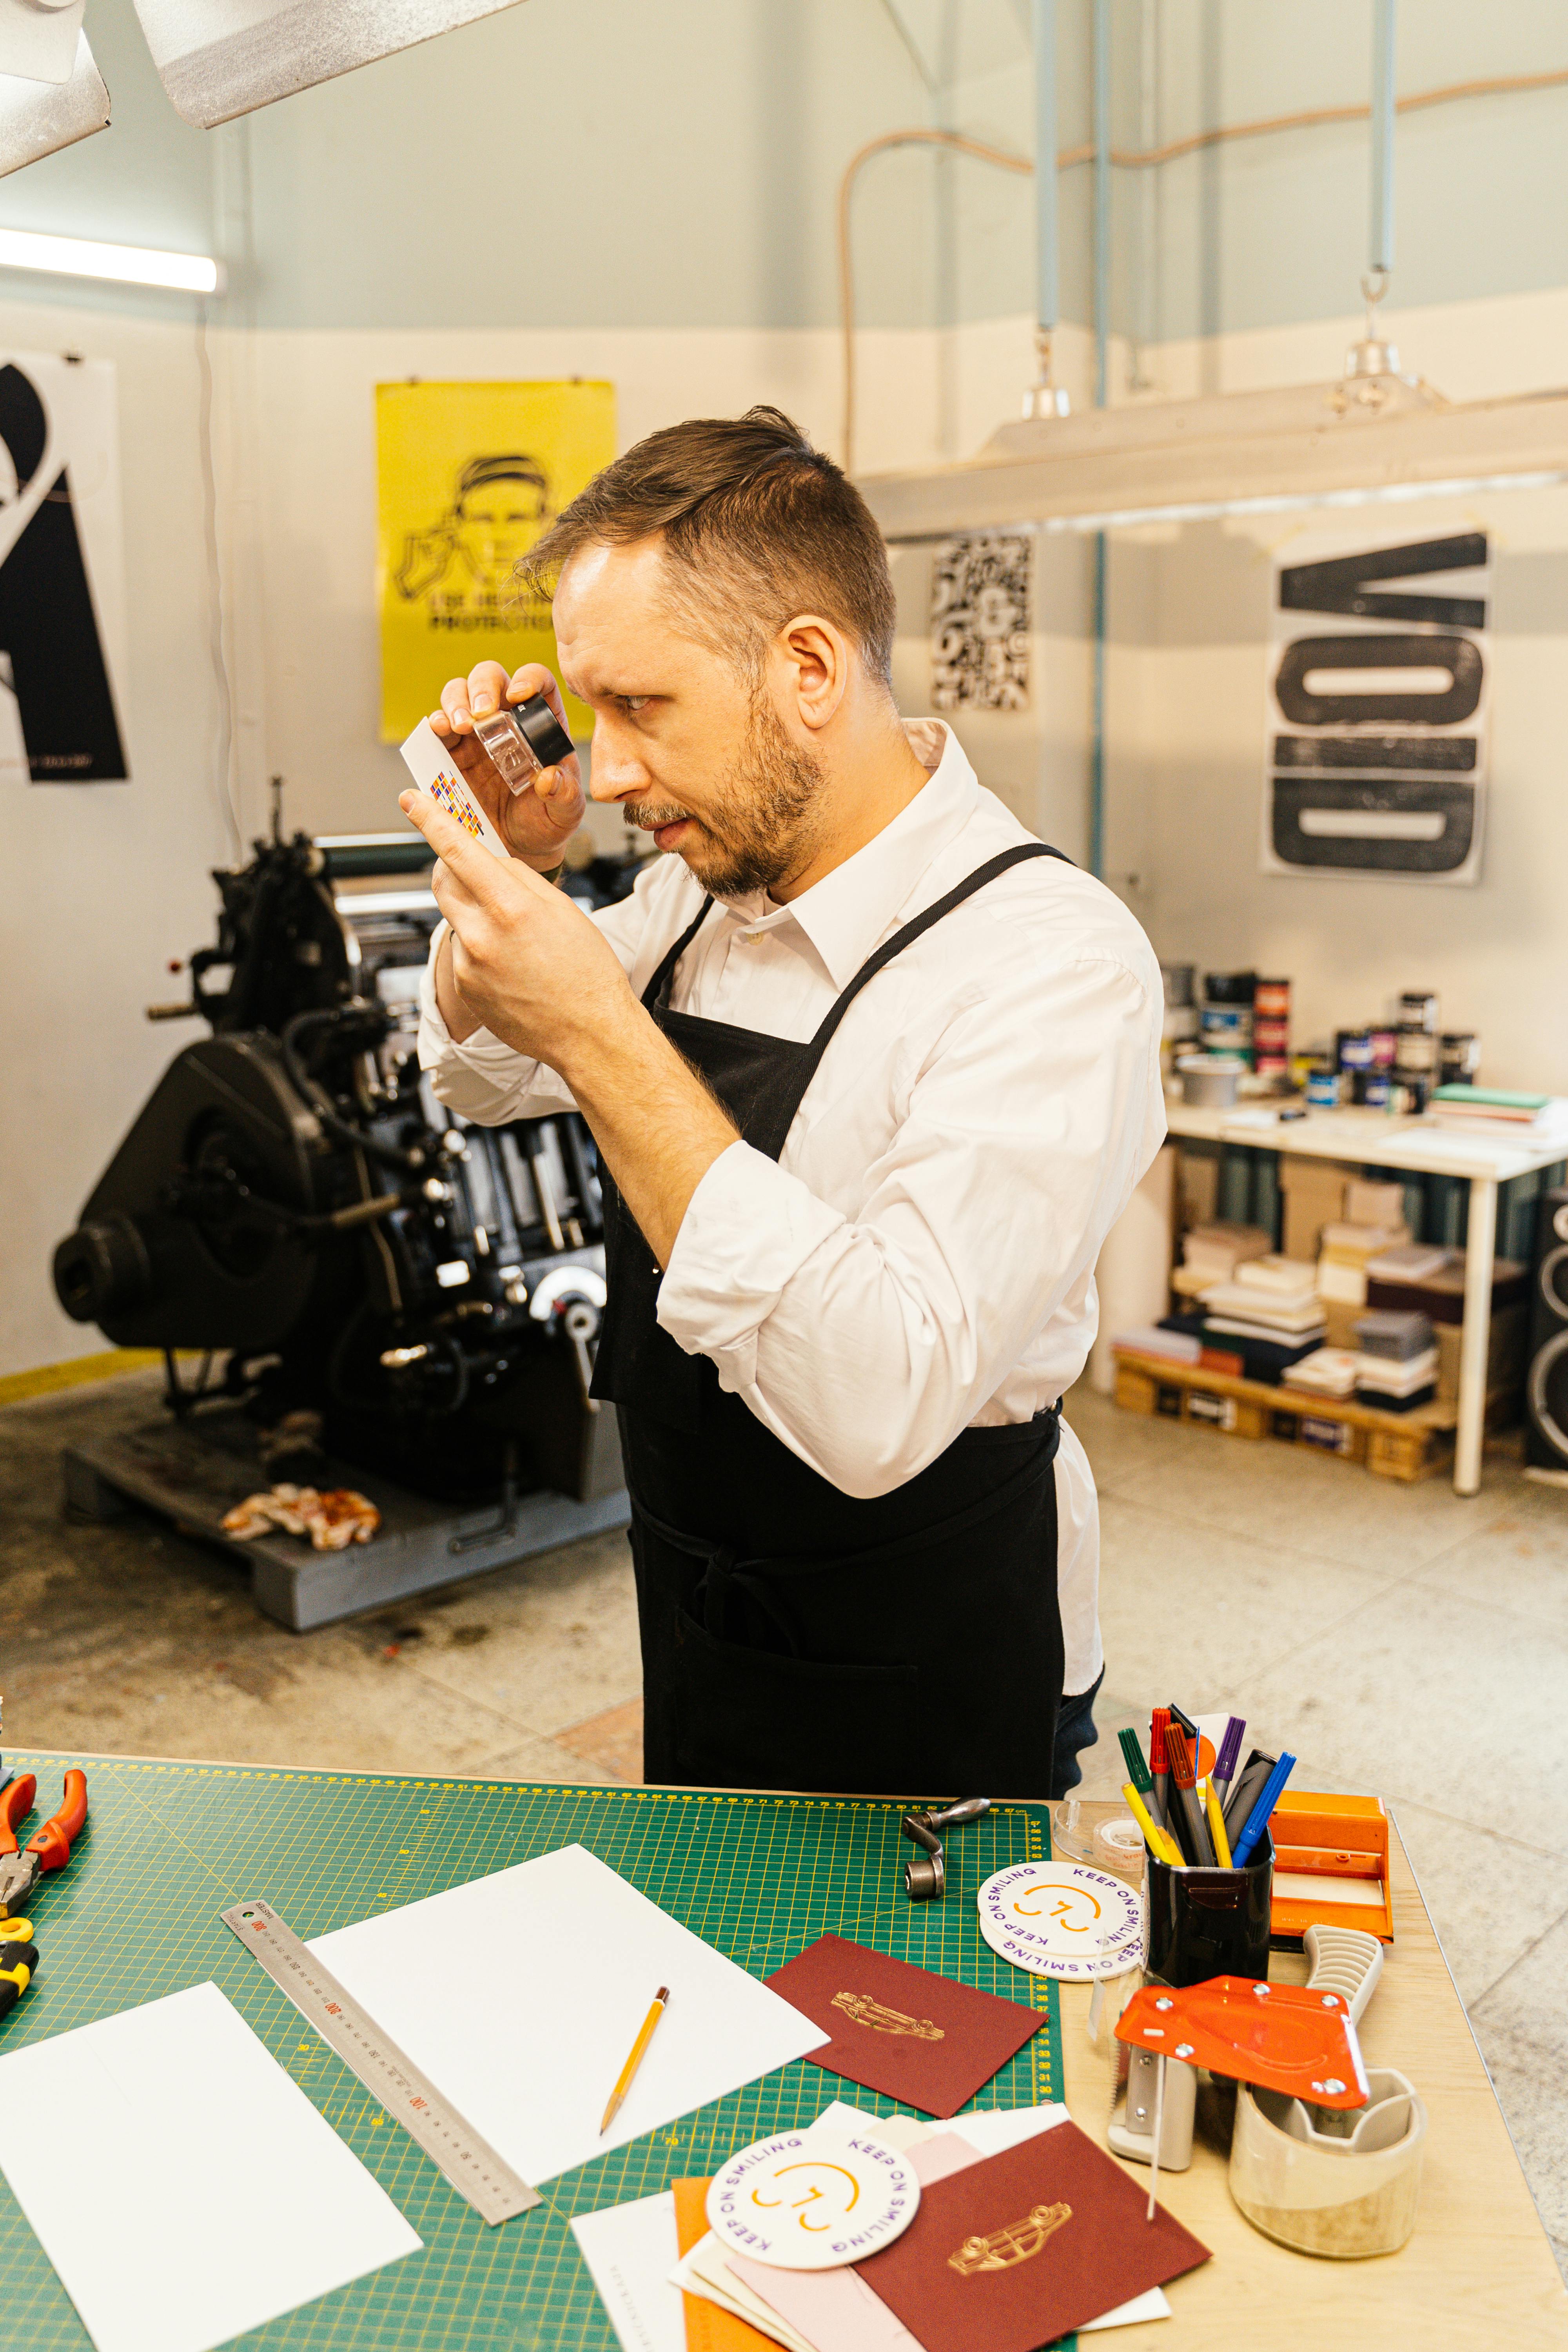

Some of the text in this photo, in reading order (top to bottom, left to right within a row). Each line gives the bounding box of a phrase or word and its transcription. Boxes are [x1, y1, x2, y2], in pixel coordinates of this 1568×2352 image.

[1275, 532, 1487, 871] VOID
[1073, 1869, 1117, 1887] KEEP
[988, 1868, 1049, 1945] KEEP ON SMILING
[1117, 1891, 1136, 1905] ON
[256, 1901, 275, 1919] MASTER
[226, 1914, 243, 1931] STARTUL
[251, 1920, 267, 1932] 300
[1095, 1909, 1139, 1946] SMILING
[1003, 1941, 1079, 1971] SMILING
[1086, 1960, 1112, 1971] ON
[325, 2002, 341, 2014] 200
[368, 2050, 381, 2058] 150
[410, 2096, 428, 2110] 100
[460, 2151, 472, 2160] 50
[720, 2138, 803, 2251] KEEP ON SMILING
[831, 2138, 907, 2252] KEEP ON SMILING
